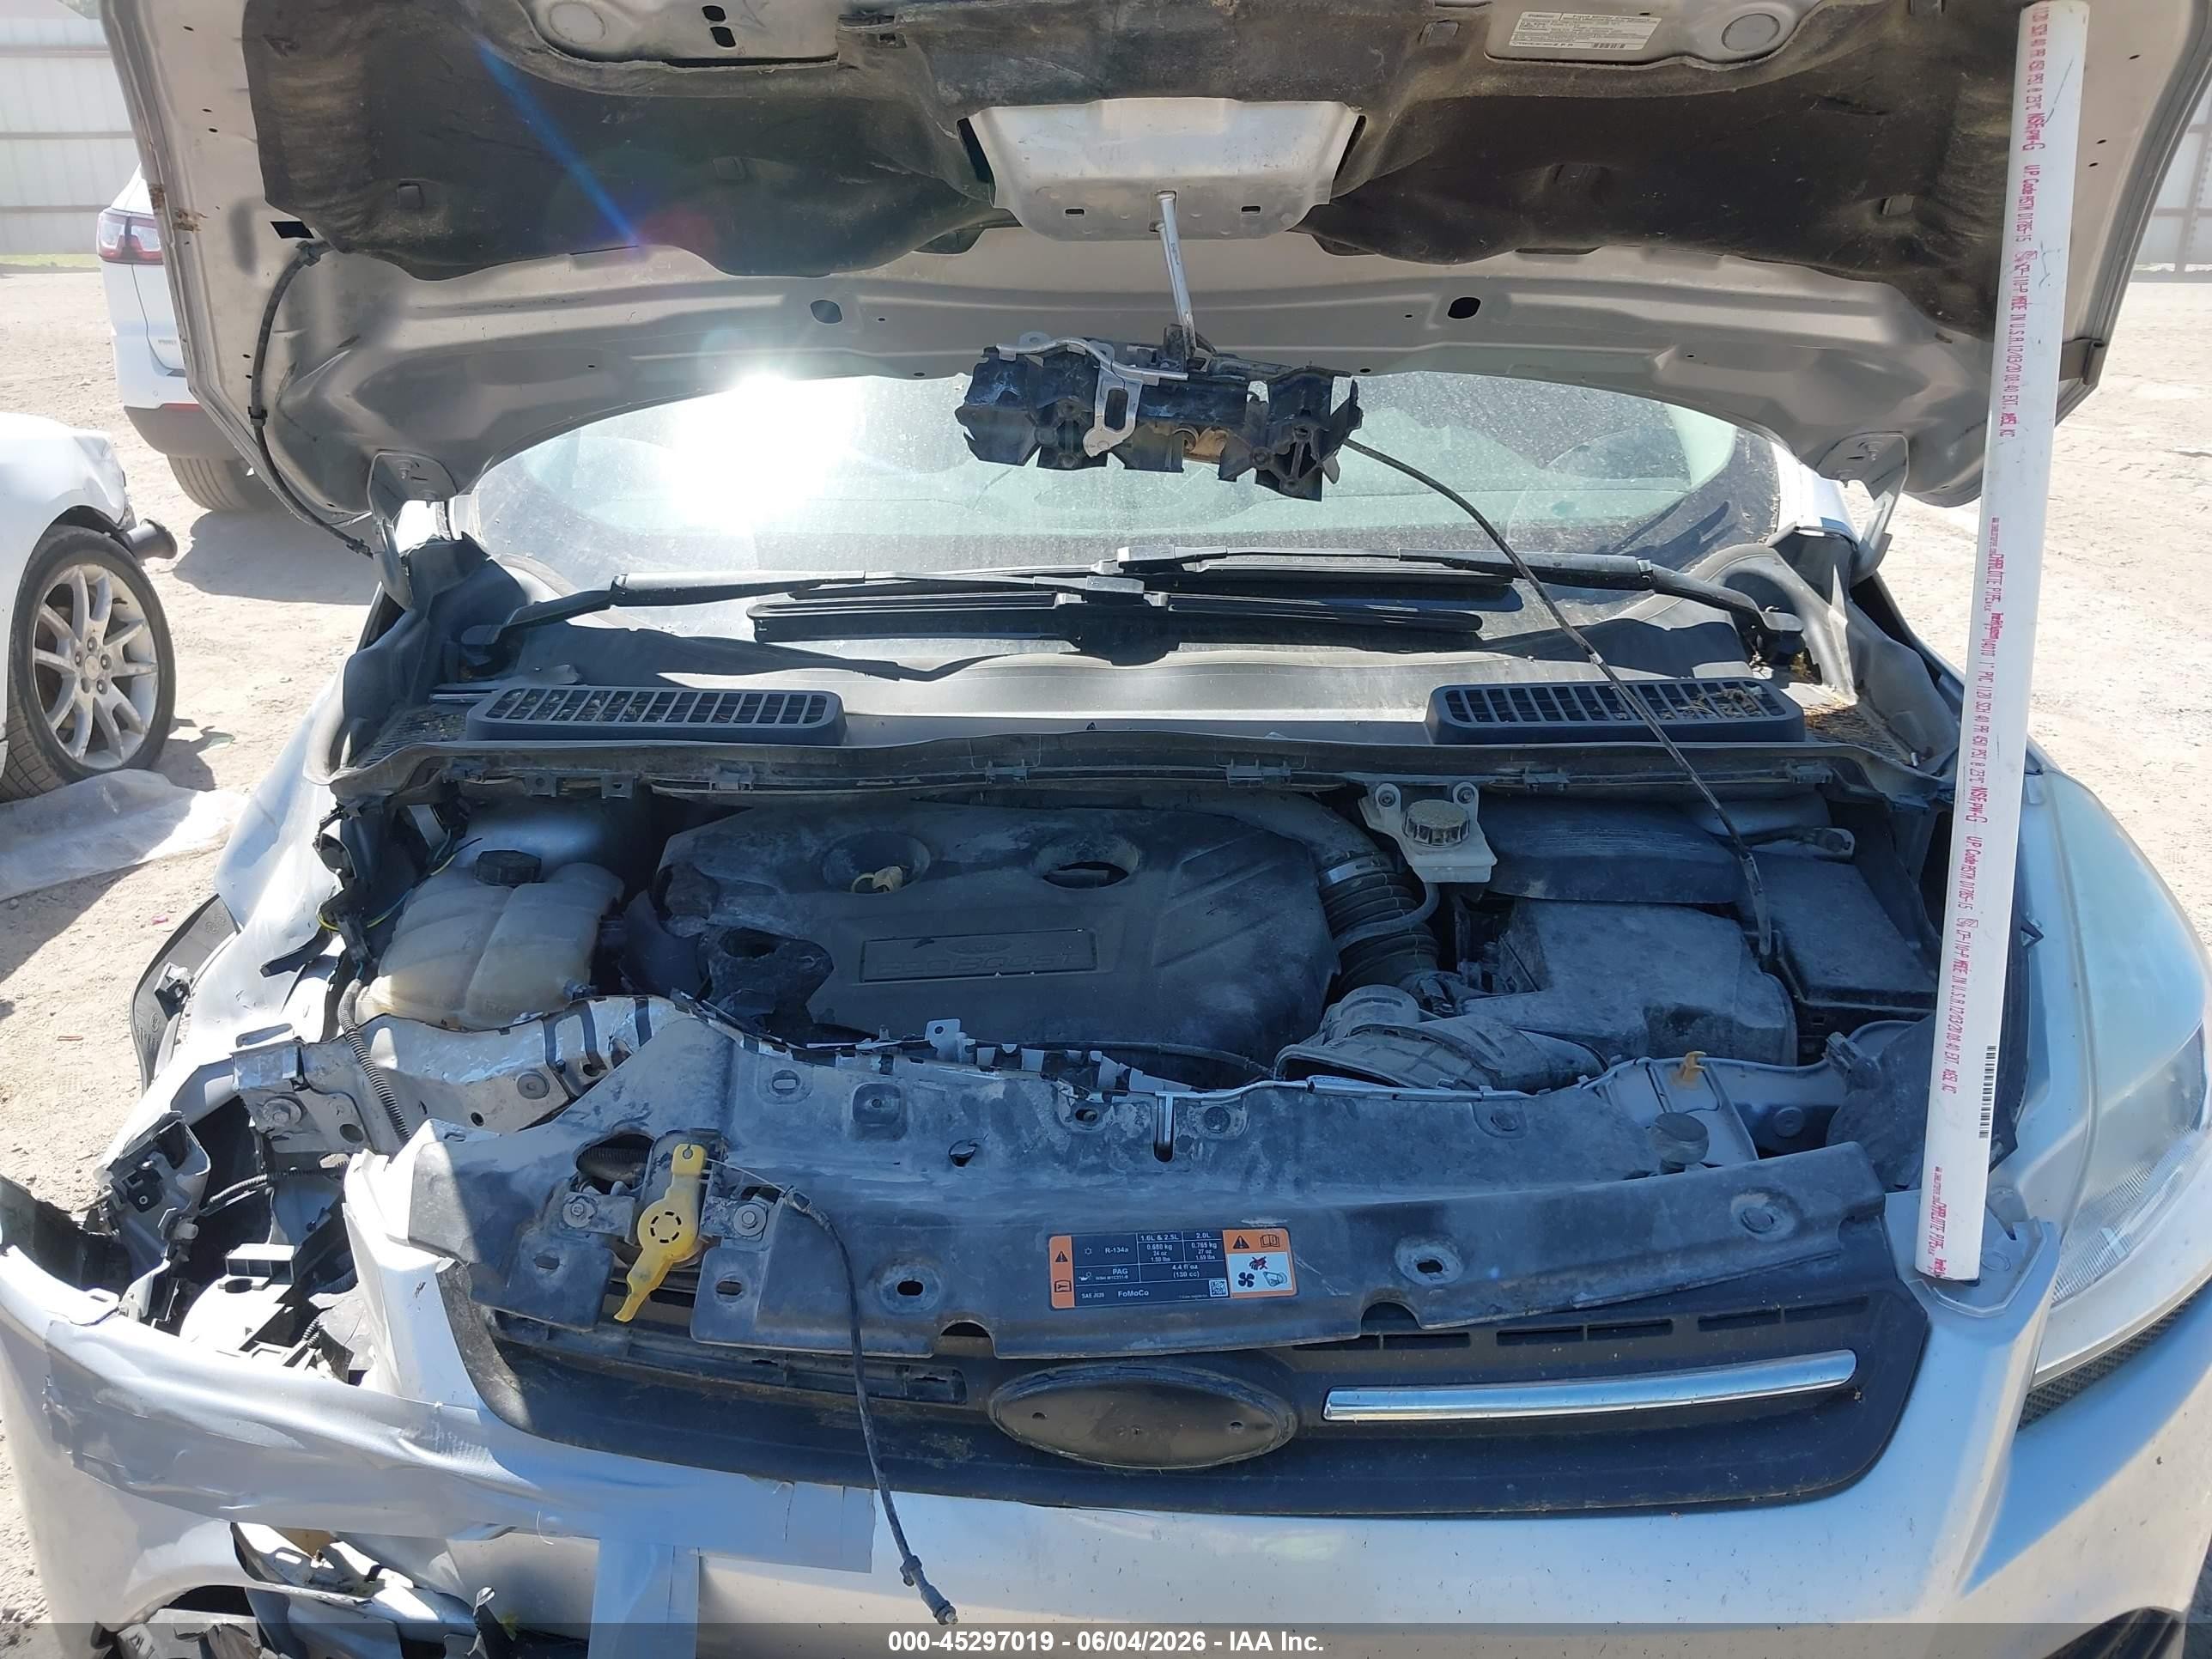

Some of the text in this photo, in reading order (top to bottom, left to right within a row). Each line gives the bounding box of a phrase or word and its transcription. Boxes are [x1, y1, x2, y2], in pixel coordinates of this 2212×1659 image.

[2022, 179, 2039, 195] Code
[2019, 196, 2033, 210] ASTM
[2011, 295, 2027, 311] MADE
[2001, 395, 2018, 410] EXT.
[1987, 553, 2003, 585] CHARLOTTE
[1985, 587, 2001, 602] PIPE
[1978, 672, 1994, 683] PVC
[1977, 685, 1992, 699] 1120
[1976, 701, 1990, 714] SCH
[1975, 714, 1989, 723] 40
[1973, 725, 1989, 734] PR
[1972, 735, 1988, 747] 450
[1972, 747, 1986, 759] PSI
[1965, 848, 1980, 865] Code
[1960, 864, 1976, 878] ASTM
[1959, 880, 1974, 911] D1785-15
[1953, 958, 1968, 975] MADE
[1952, 975, 1966, 985] IN
[1944, 1051, 1960, 1066] EXT.
[1942, 1083, 1956, 1095] KC
[1930, 1202, 1946, 1232] CHARLOTTE
[1929, 1231, 1944, 1249] PIPE
